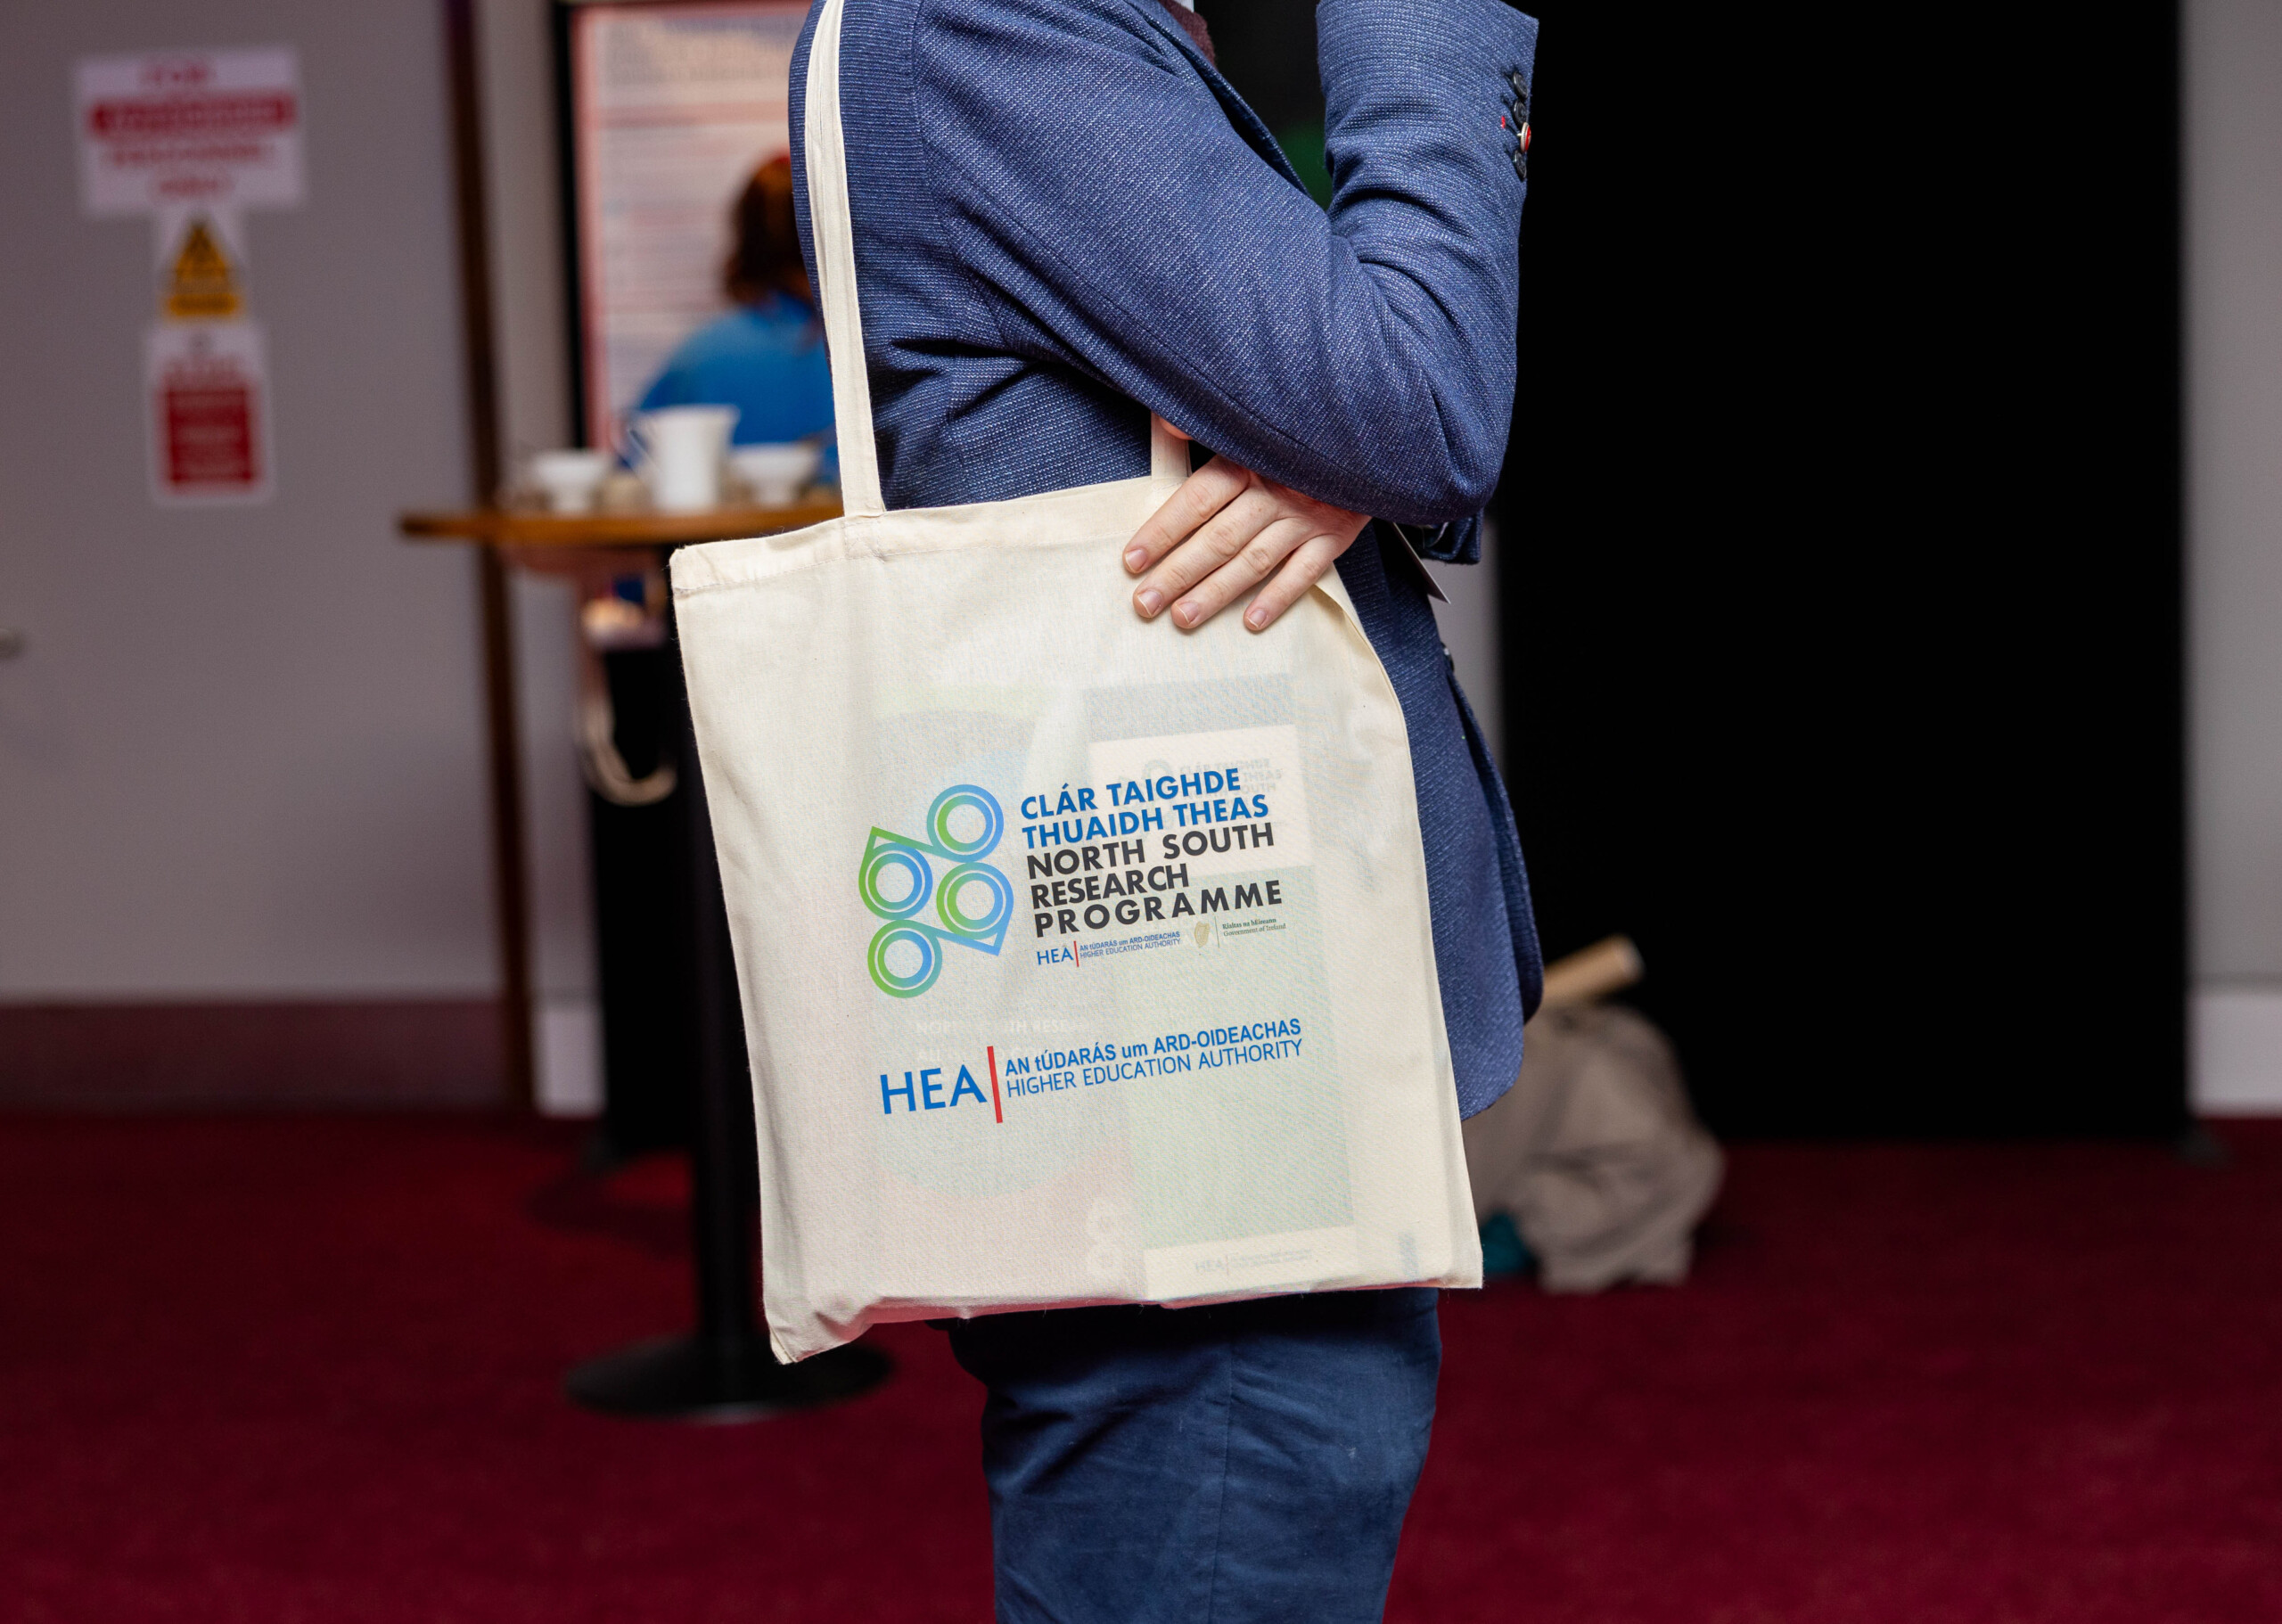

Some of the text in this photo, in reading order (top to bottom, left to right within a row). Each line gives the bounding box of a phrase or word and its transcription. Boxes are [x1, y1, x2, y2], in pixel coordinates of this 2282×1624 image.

[1021, 767, 1241, 820] CLÁR TAIGHDE
[1022, 793, 1269, 849] THUAIDH THEAS
[1026, 822, 1275, 881] NORTH SOUTH
[1030, 863, 1190, 911] RESEARCH
[1034, 880, 1283, 939] PROGRAMME
[1036, 947, 1074, 966] HEA
[1079, 943, 1088, 951] AN
[1129, 931, 1181, 944] ARD-OIDEACHAS
[1079, 938, 1181, 959] HIGHER EDUCATION AUTHORITY
[1005, 1056, 1030, 1077] AN
[1034, 1041, 1117, 1072] tÚDARÁS
[1120, 1043, 1149, 1059] um
[1153, 1017, 1302, 1054] ARD-OIDEACHAS
[1006, 1070, 1077, 1098] HIGHER
[1082, 1054, 1193, 1087] EDUCATION
[1198, 1038, 1302, 1070] AUTHORITY
[879, 1063, 989, 1115] HEA
